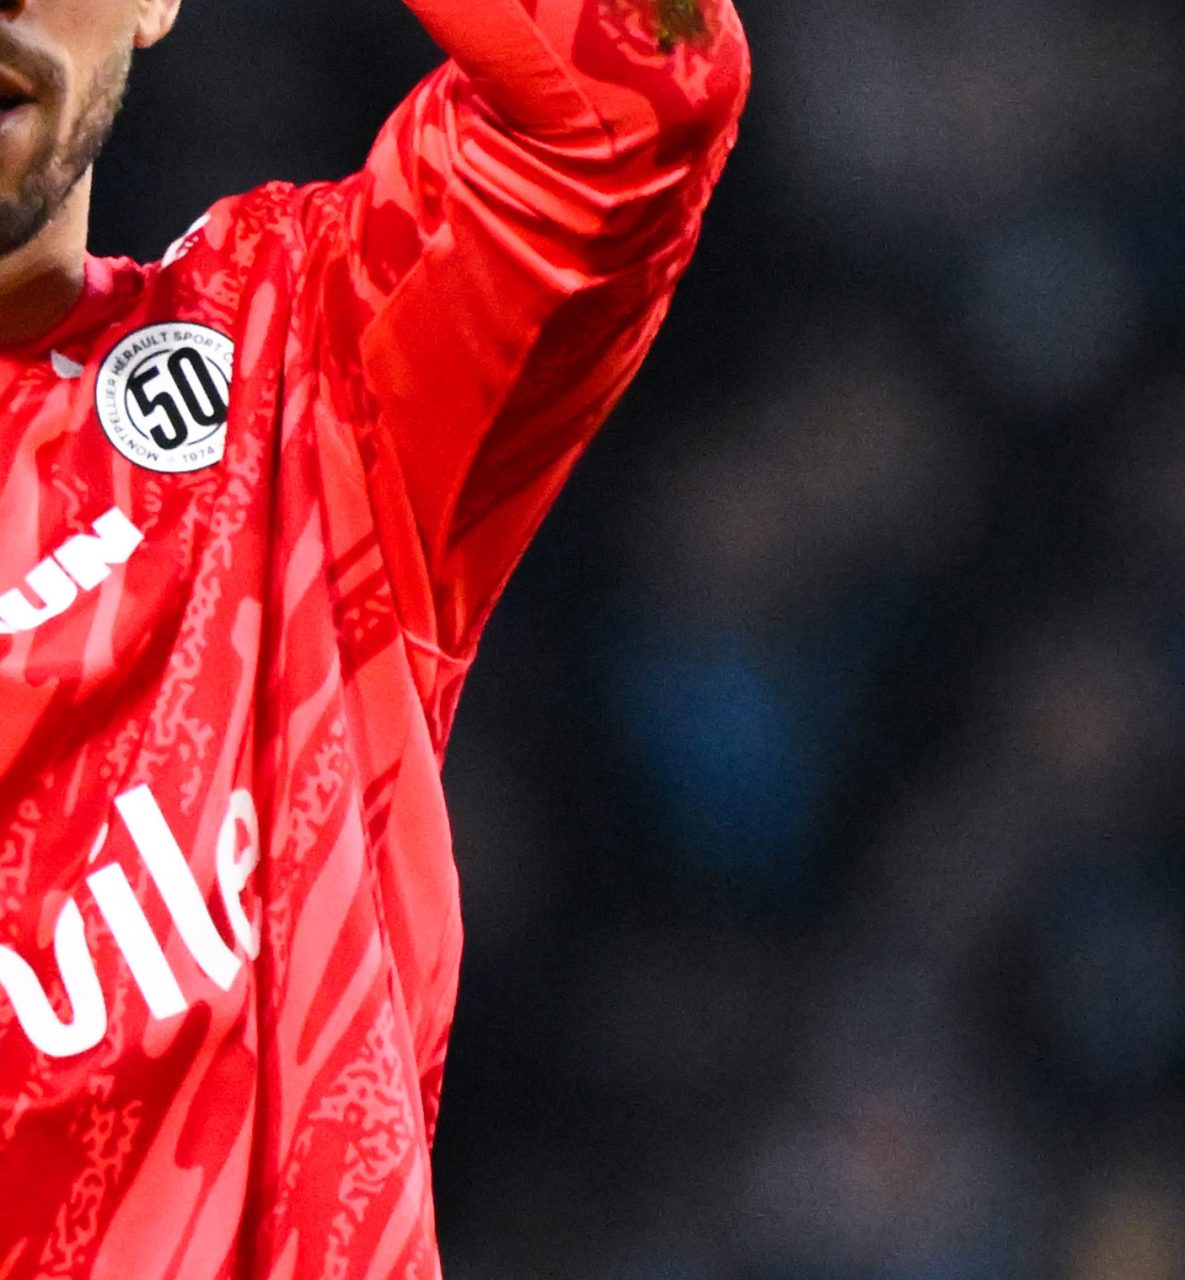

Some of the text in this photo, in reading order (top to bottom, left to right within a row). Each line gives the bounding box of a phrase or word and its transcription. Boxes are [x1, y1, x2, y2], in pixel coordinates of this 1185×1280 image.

[106, 378, 160, 462] MONTPELLIER
[173, 331, 223, 351] SPORT
[127, 347, 228, 450] 50
[182, 445, 216, 463] 1974
